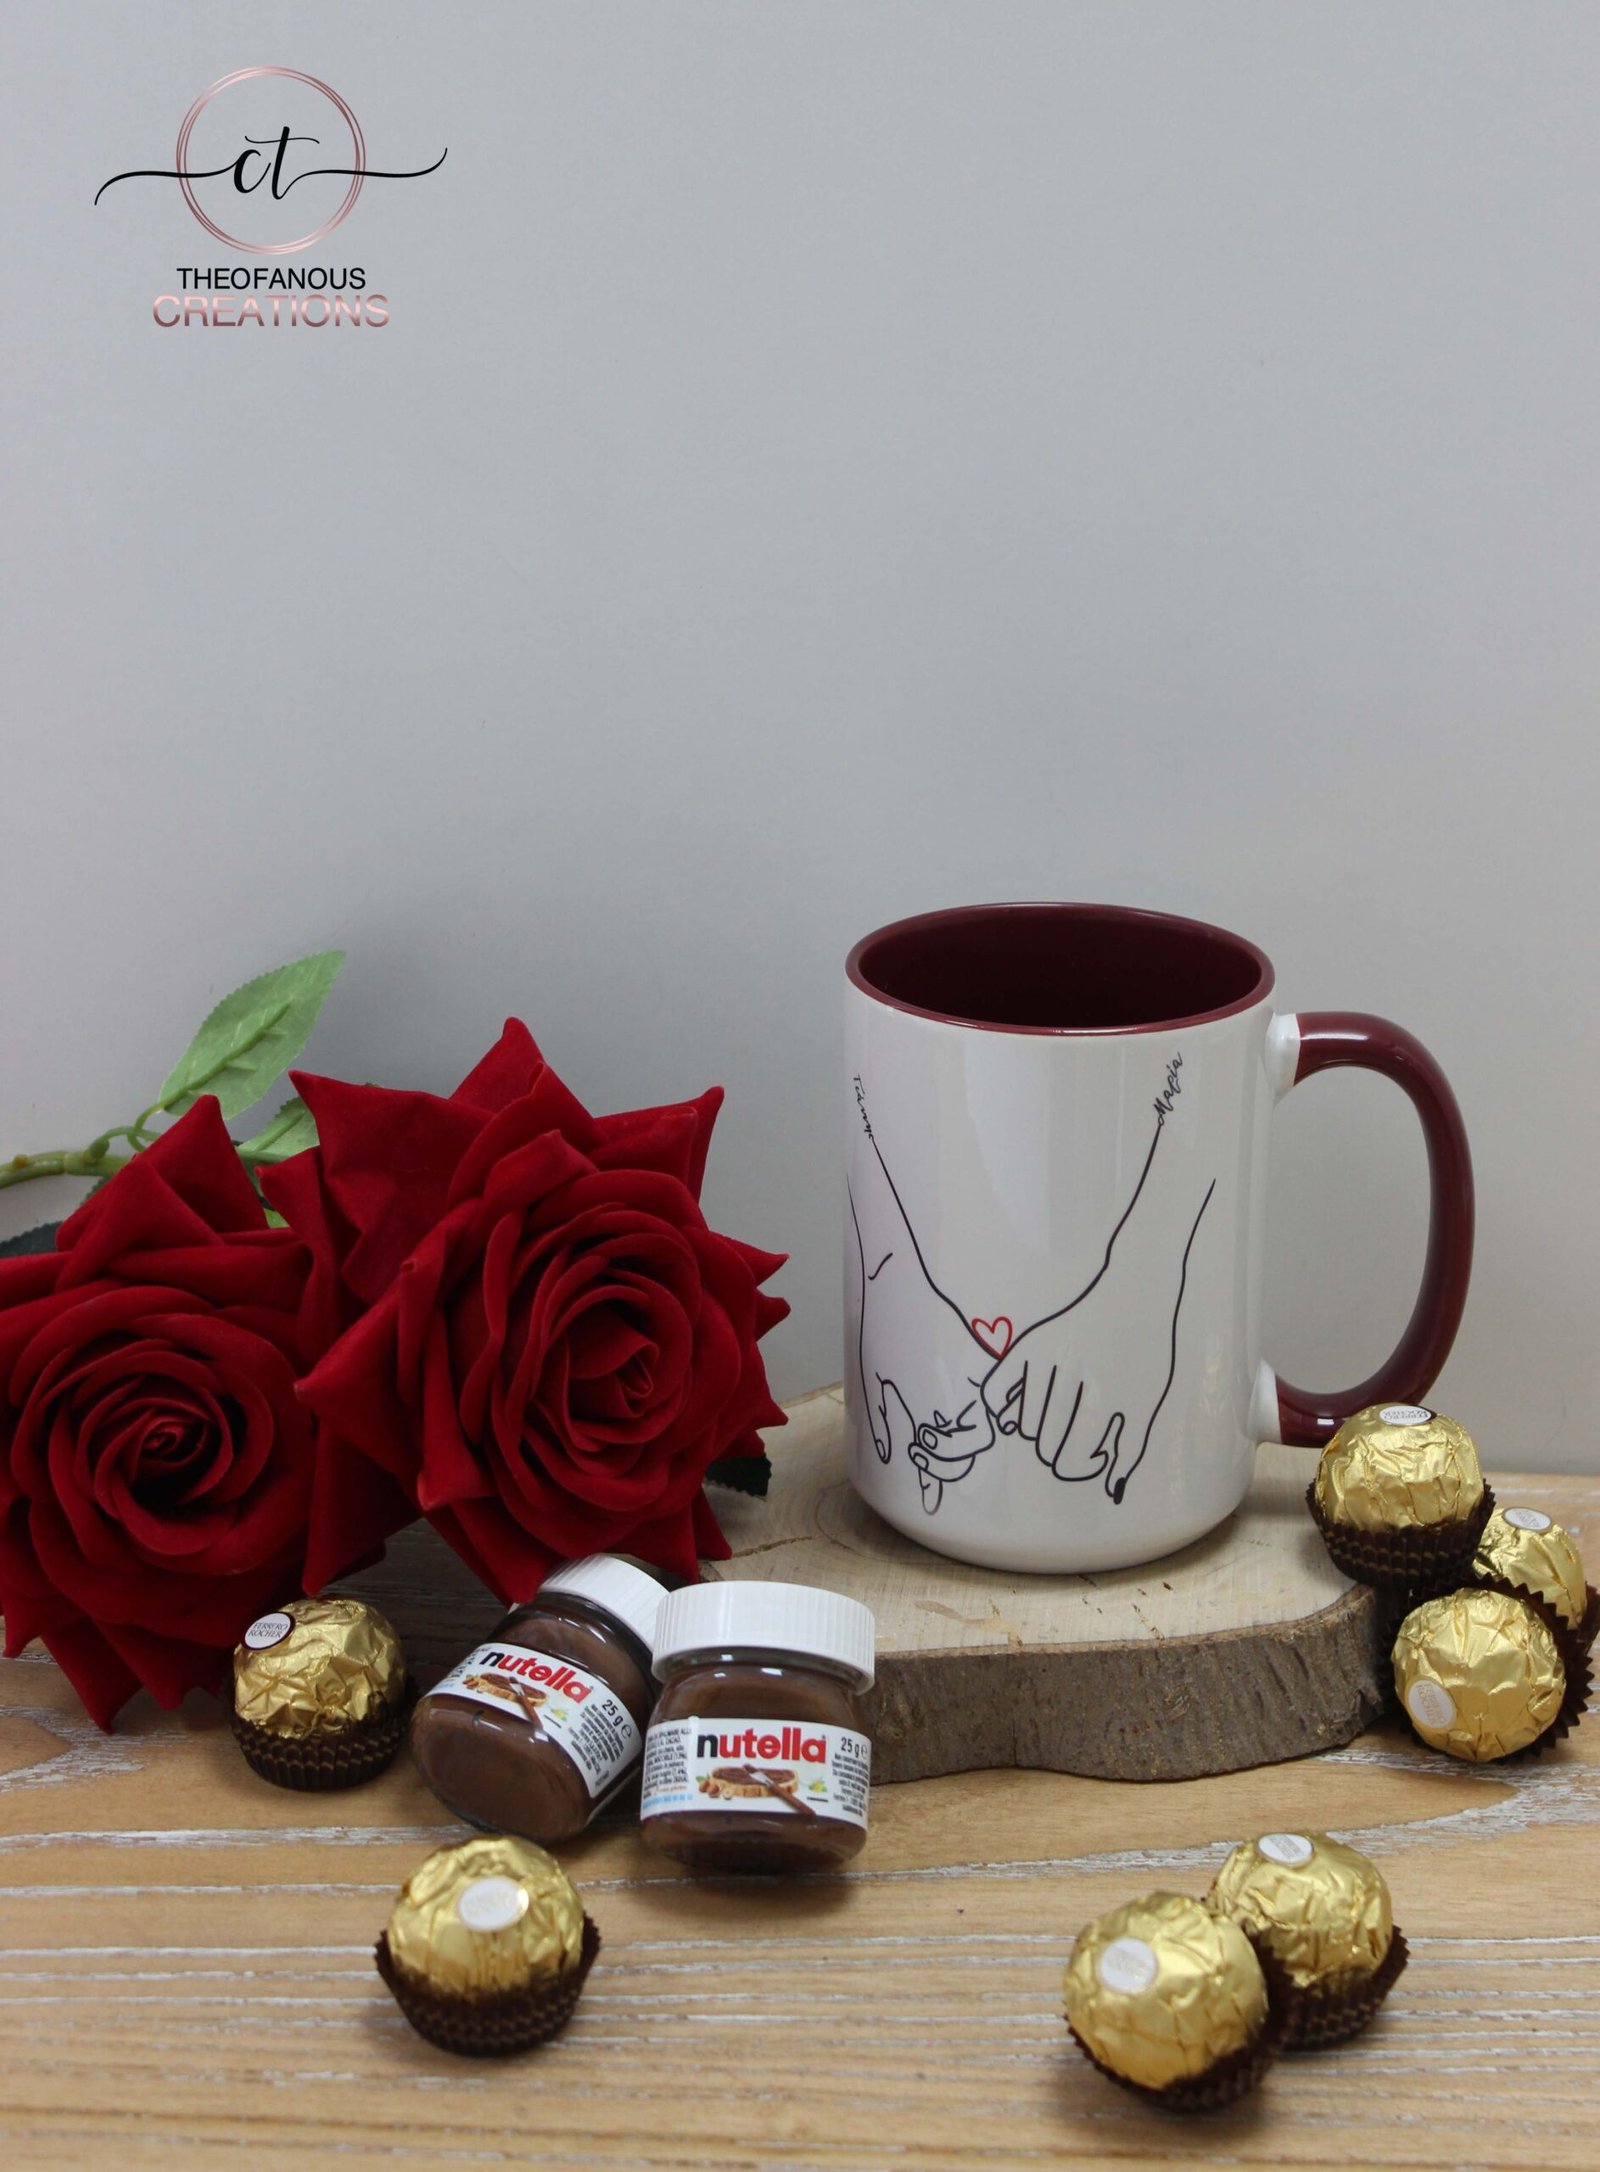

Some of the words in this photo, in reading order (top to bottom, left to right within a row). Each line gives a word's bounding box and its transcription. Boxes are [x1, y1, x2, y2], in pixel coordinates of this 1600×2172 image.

[479, 1650, 592, 1704] nutella
[601, 1699, 619, 1718] 25
[696, 1726, 826, 1764] nutella
[840, 1736, 853, 1754] 25
[854, 1744, 861, 1758] g
